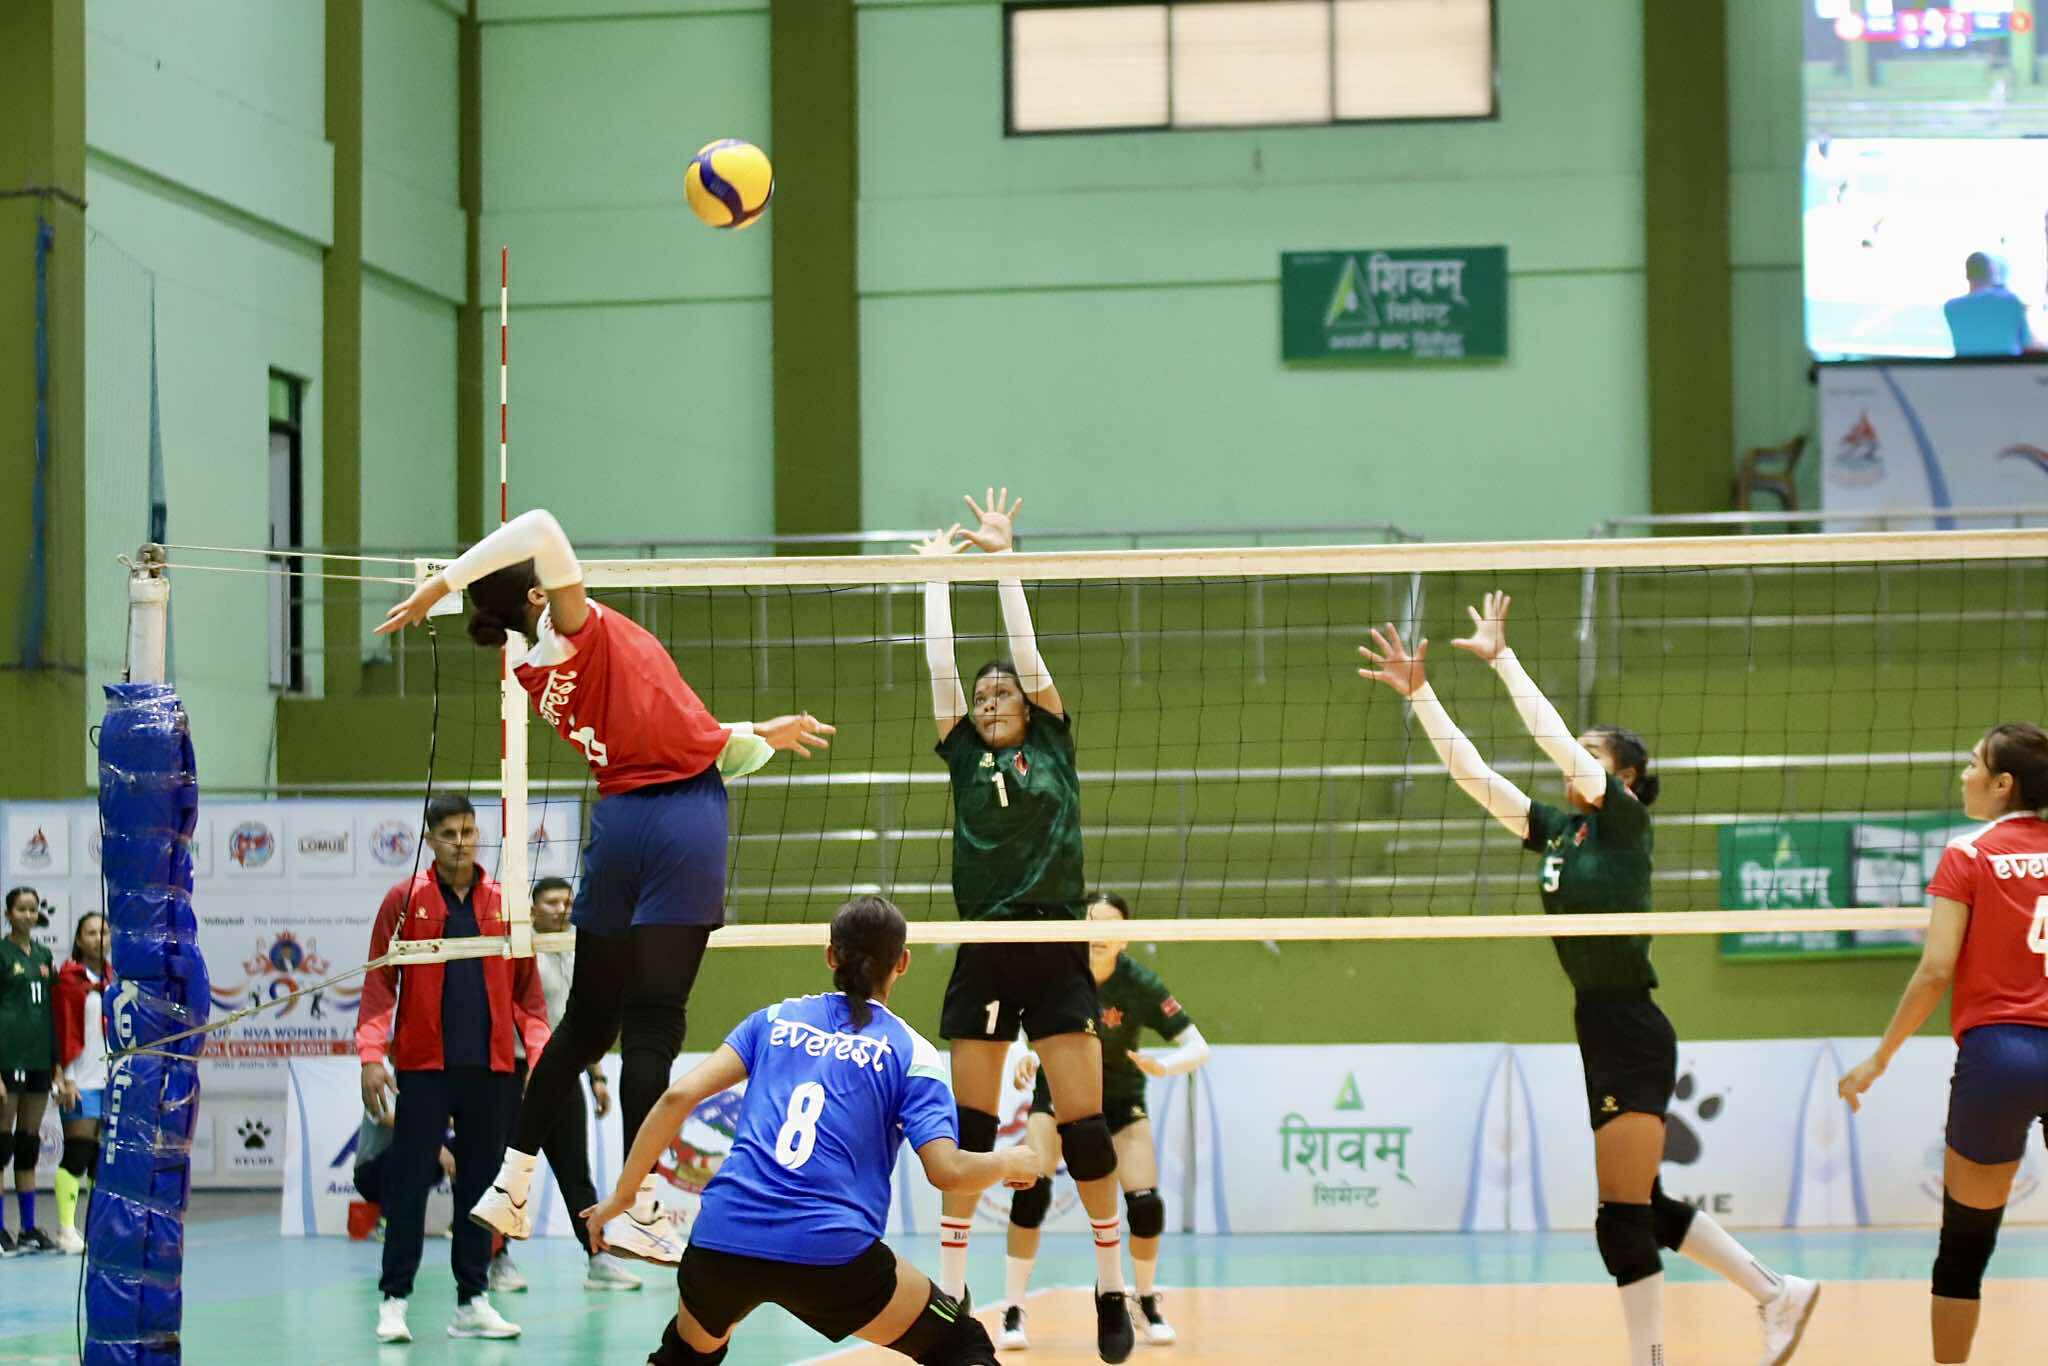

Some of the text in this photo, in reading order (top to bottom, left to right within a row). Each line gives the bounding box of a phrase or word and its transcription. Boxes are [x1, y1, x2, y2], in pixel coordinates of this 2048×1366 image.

[1368, 252, 1471, 306] शिवम्
[991, 771, 1009, 808] 1
[1544, 856, 1564, 892] 5
[30, 981, 42, 1003] 11
[984, 1000, 1000, 1034] 1
[769, 1018, 893, 1072] everest
[775, 1081, 826, 1170] 8
[1279, 1112, 1416, 1189] शिवम्
[1312, 1178, 1380, 1208] सिमेन्ट
